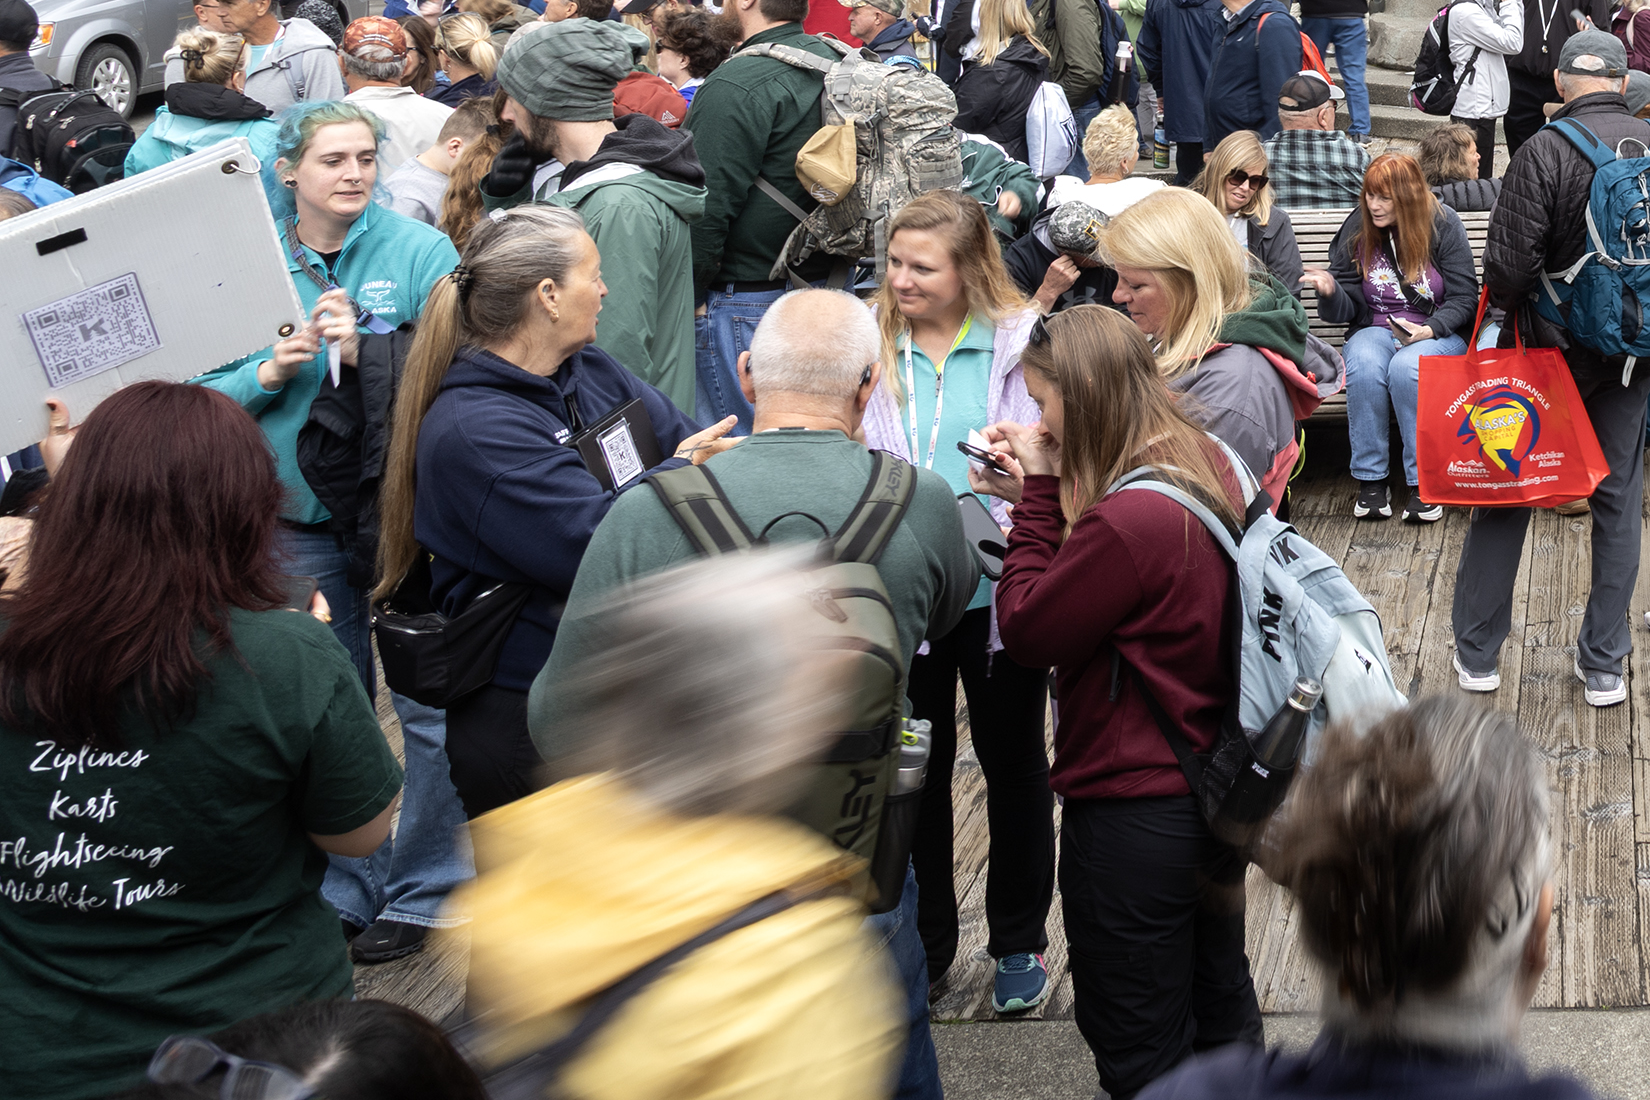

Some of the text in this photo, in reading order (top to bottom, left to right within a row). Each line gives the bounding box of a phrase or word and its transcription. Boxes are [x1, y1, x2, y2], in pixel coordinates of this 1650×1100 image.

[360, 280, 397, 291] JUNEAU
[372, 306, 397, 314] ASKA
[78, 317, 108, 343] K
[1445, 377, 1551, 419] TONGASS TRADING TRIANGLE
[1474, 411, 1526, 430] ALASKA'S
[1481, 425, 1516, 437] SHOPPING
[1483, 433, 1514, 442] CAPITAL
[619, 451, 625, 460] K
[1529, 451, 1565, 462] Ketchikan
[1538, 459, 1562, 468] Alaska
[1447, 461, 1486, 474] Alaskan
[1454, 474, 1559, 490] www.tongasstrading.com
[1260, 586, 1283, 663] PINK
[29, 740, 150, 782] Ziplines
[49, 788, 119, 823] Karts
[0, 832, 175, 878] Flightseeing
[112, 877, 187, 911] Tours
